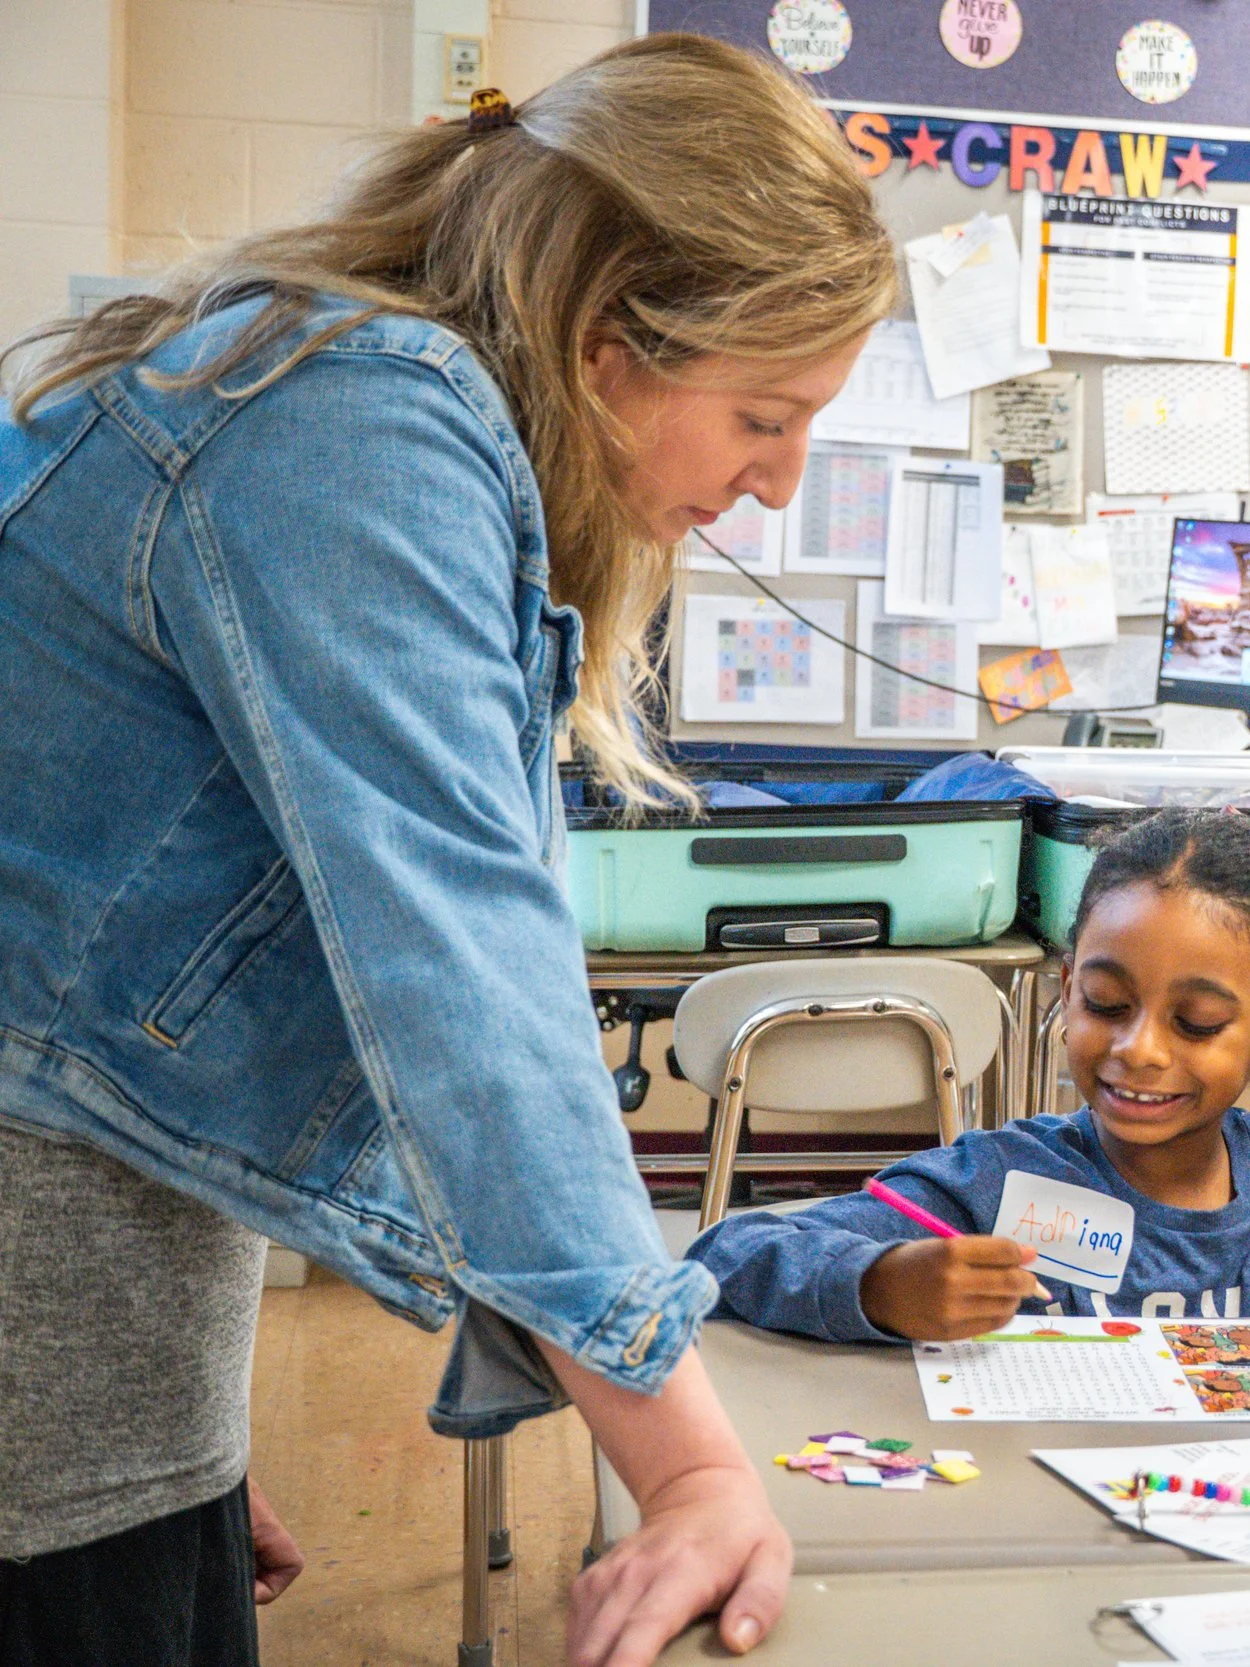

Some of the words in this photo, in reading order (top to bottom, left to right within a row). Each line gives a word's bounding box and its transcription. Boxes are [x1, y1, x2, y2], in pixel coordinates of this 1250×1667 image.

[958, 0, 1008, 21] NEVER
[957, 19, 998, 39] give
[780, 38, 840, 57] YOURSELF
[970, 35, 991, 61] up
[1140, 36, 1173, 52] MAKE
[1150, 53, 1164, 69] IT
[1132, 71, 1181, 88] HAPPEN
[951, 123, 1168, 199] CRAW
[1048, 196, 1134, 216] BLUEPRINT
[1142, 201, 1231, 223] QUESTIONS
